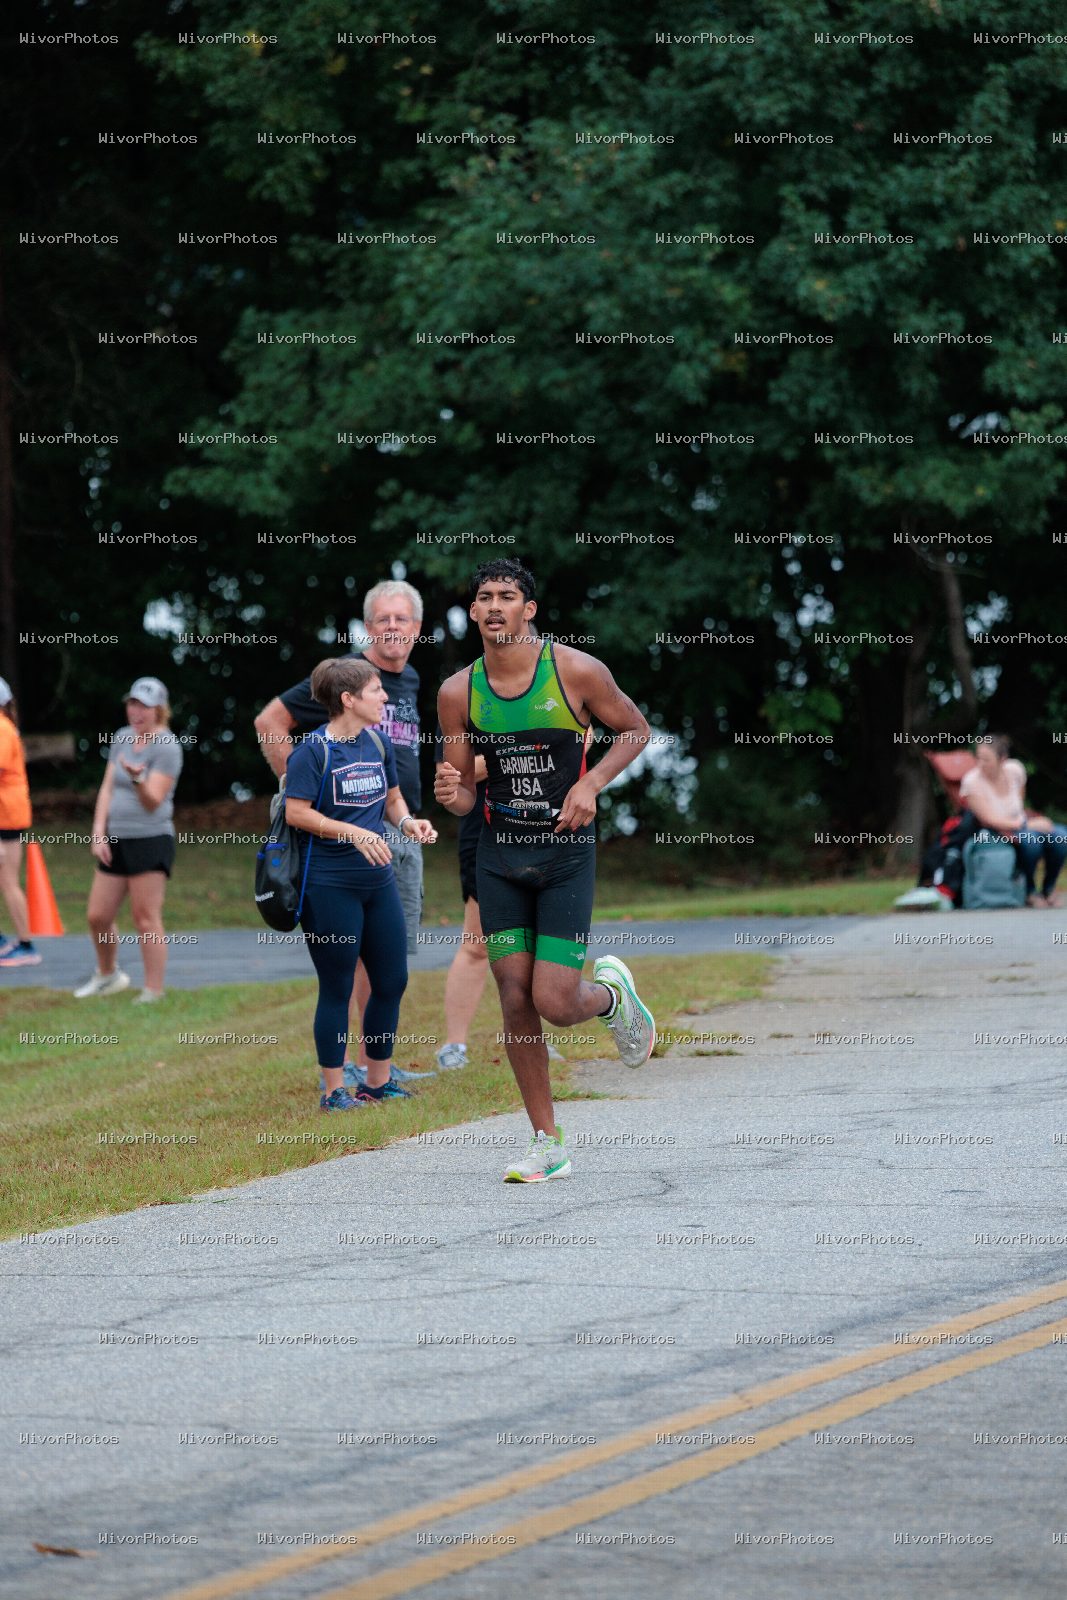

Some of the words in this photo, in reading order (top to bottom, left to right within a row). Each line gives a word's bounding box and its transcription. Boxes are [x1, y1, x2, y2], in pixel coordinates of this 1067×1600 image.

[500, 754, 556, 775] GARIMELLA
[342, 775, 382, 794] NATIONALS
[511, 777, 543, 796] USA
